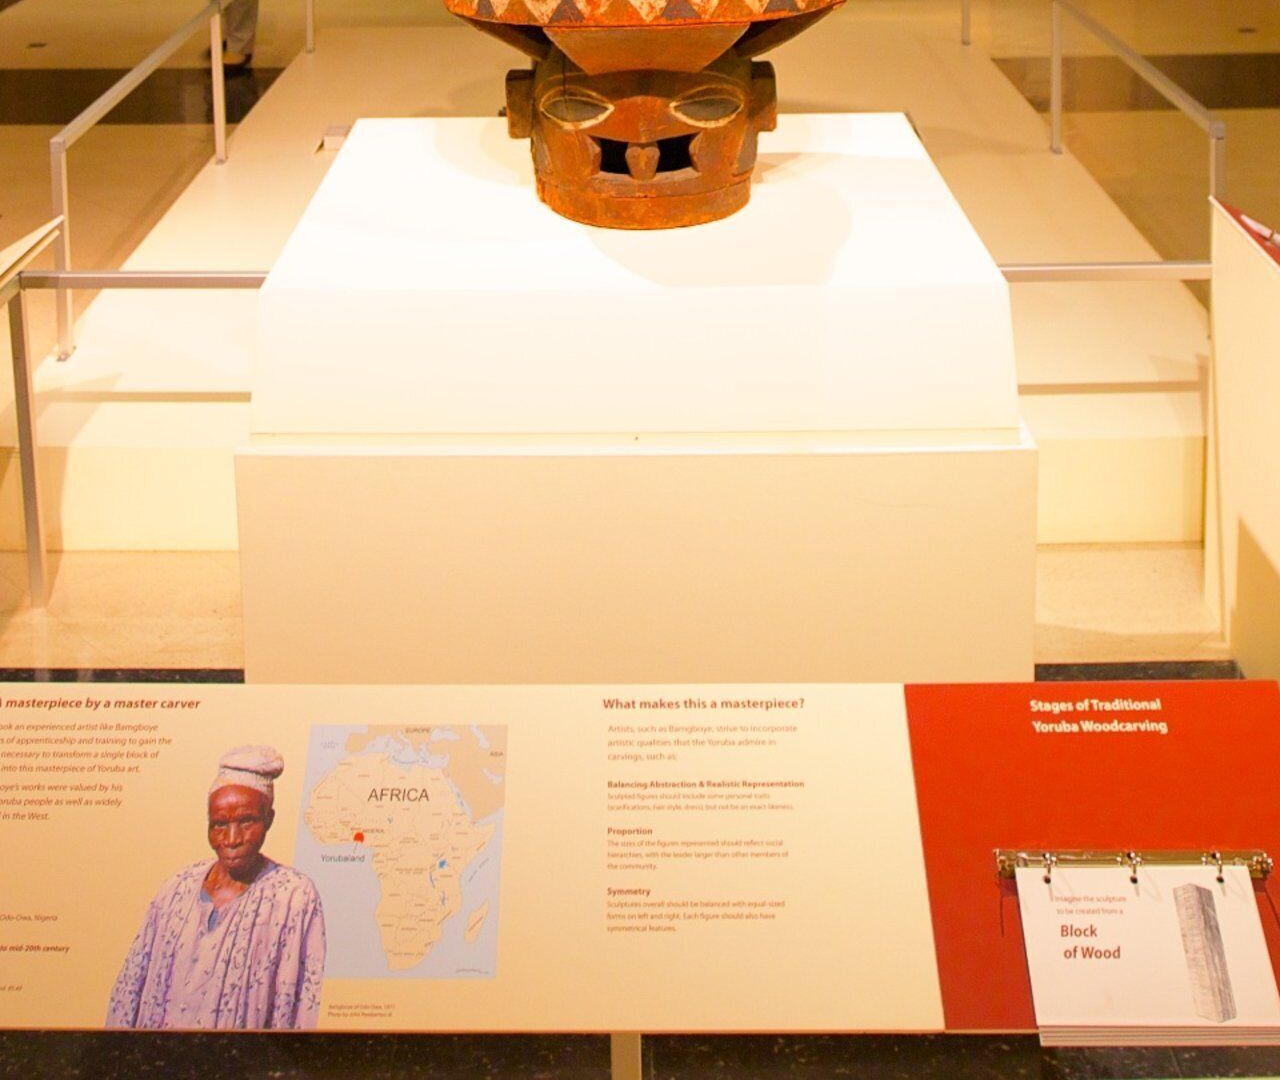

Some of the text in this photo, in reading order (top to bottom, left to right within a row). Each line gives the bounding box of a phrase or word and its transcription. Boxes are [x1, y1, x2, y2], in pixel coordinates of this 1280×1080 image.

[5, 698, 81, 711] masterpiece
[84, 698, 100, 711] by
[113, 698, 157, 709] master
[159, 701, 200, 709] carver
[603, 698, 635, 708] What
[639, 698, 679, 708] makes
[683, 698, 706, 708] this
[720, 698, 804, 711] masterpiece?
[1030, 698, 1161, 712] Stages of Traditional
[1032, 720, 1167, 734] Yoruba Woodcarving
[608, 780, 647, 789] Balancing
[742, 780, 804, 789] Representation
[368, 788, 430, 802] AFRICA
[607, 827, 652, 837] Proportion
[321, 854, 365, 863] Yorubaland
[607, 888, 650, 897] Symmetry
[1060, 924, 1097, 937] Block
[1064, 946, 1120, 959] of Wood
